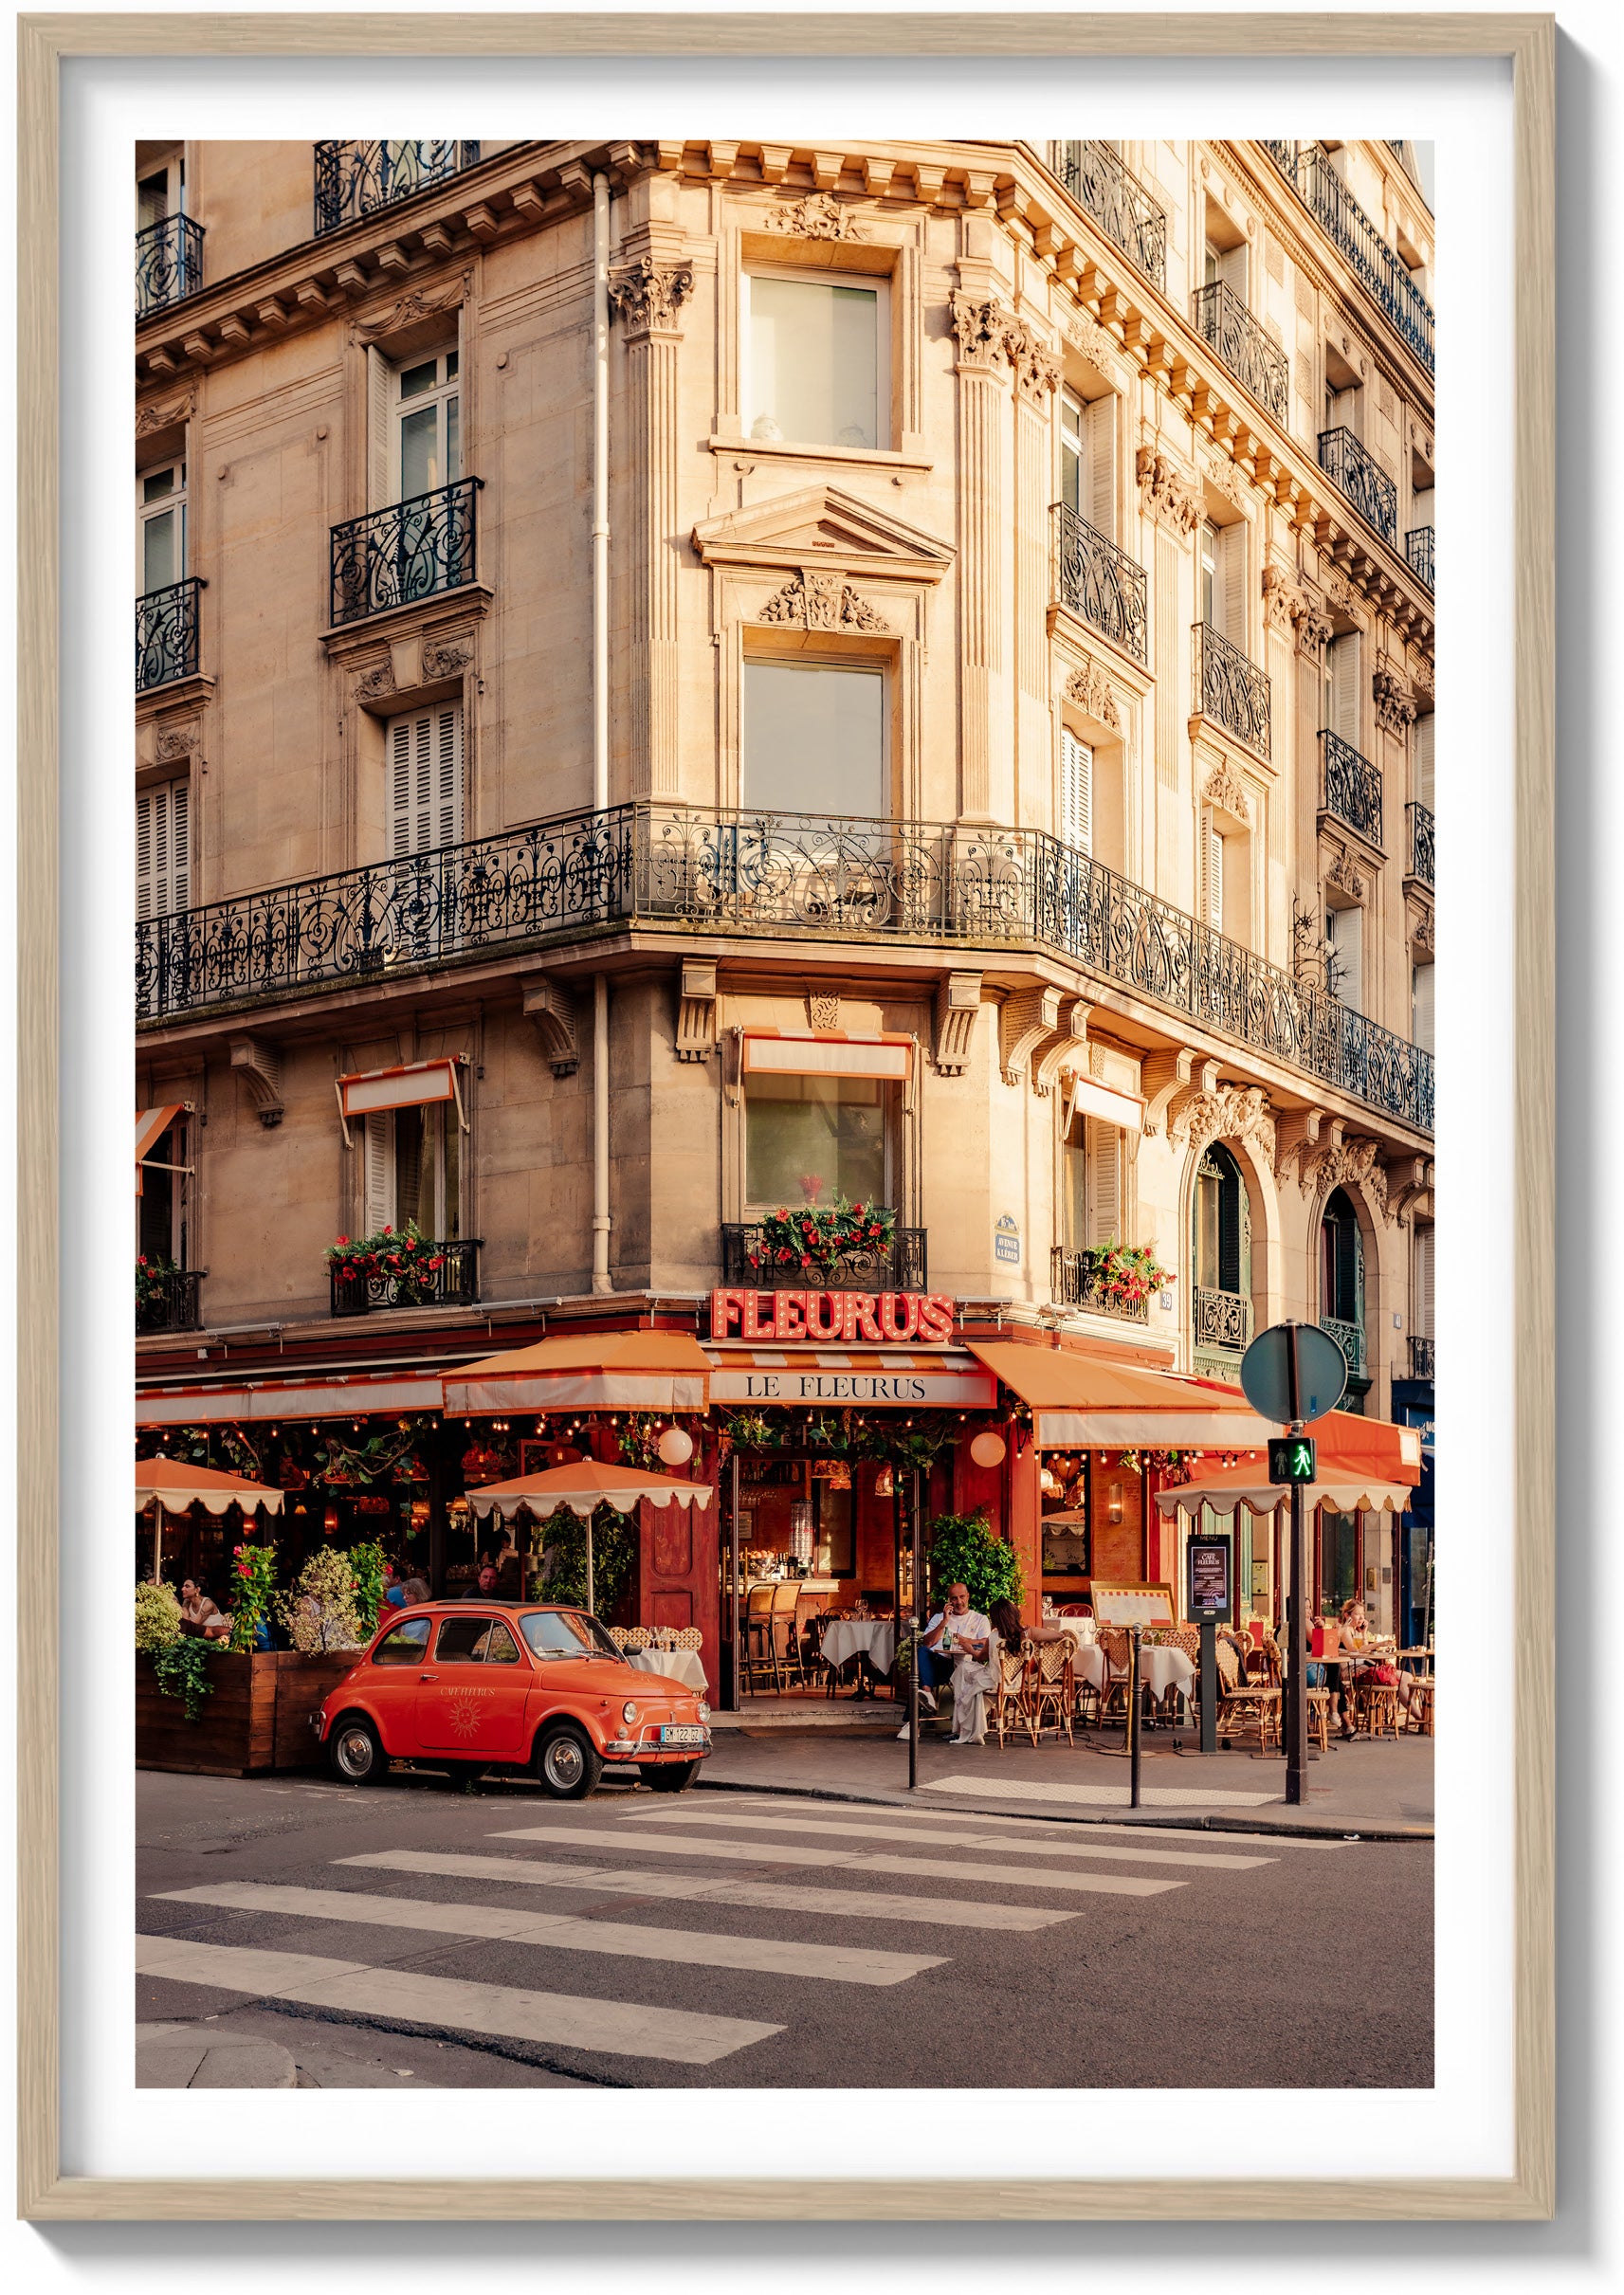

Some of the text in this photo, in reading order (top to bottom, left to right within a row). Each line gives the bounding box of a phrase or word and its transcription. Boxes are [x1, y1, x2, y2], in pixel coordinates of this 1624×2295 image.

[998, 1237, 1018, 1250] AVENUE
[1162, 1293, 1171, 1308] 39
[712, 1288, 954, 1341] FLEURUS
[745, 1375, 926, 1400] LE FLEURUS
